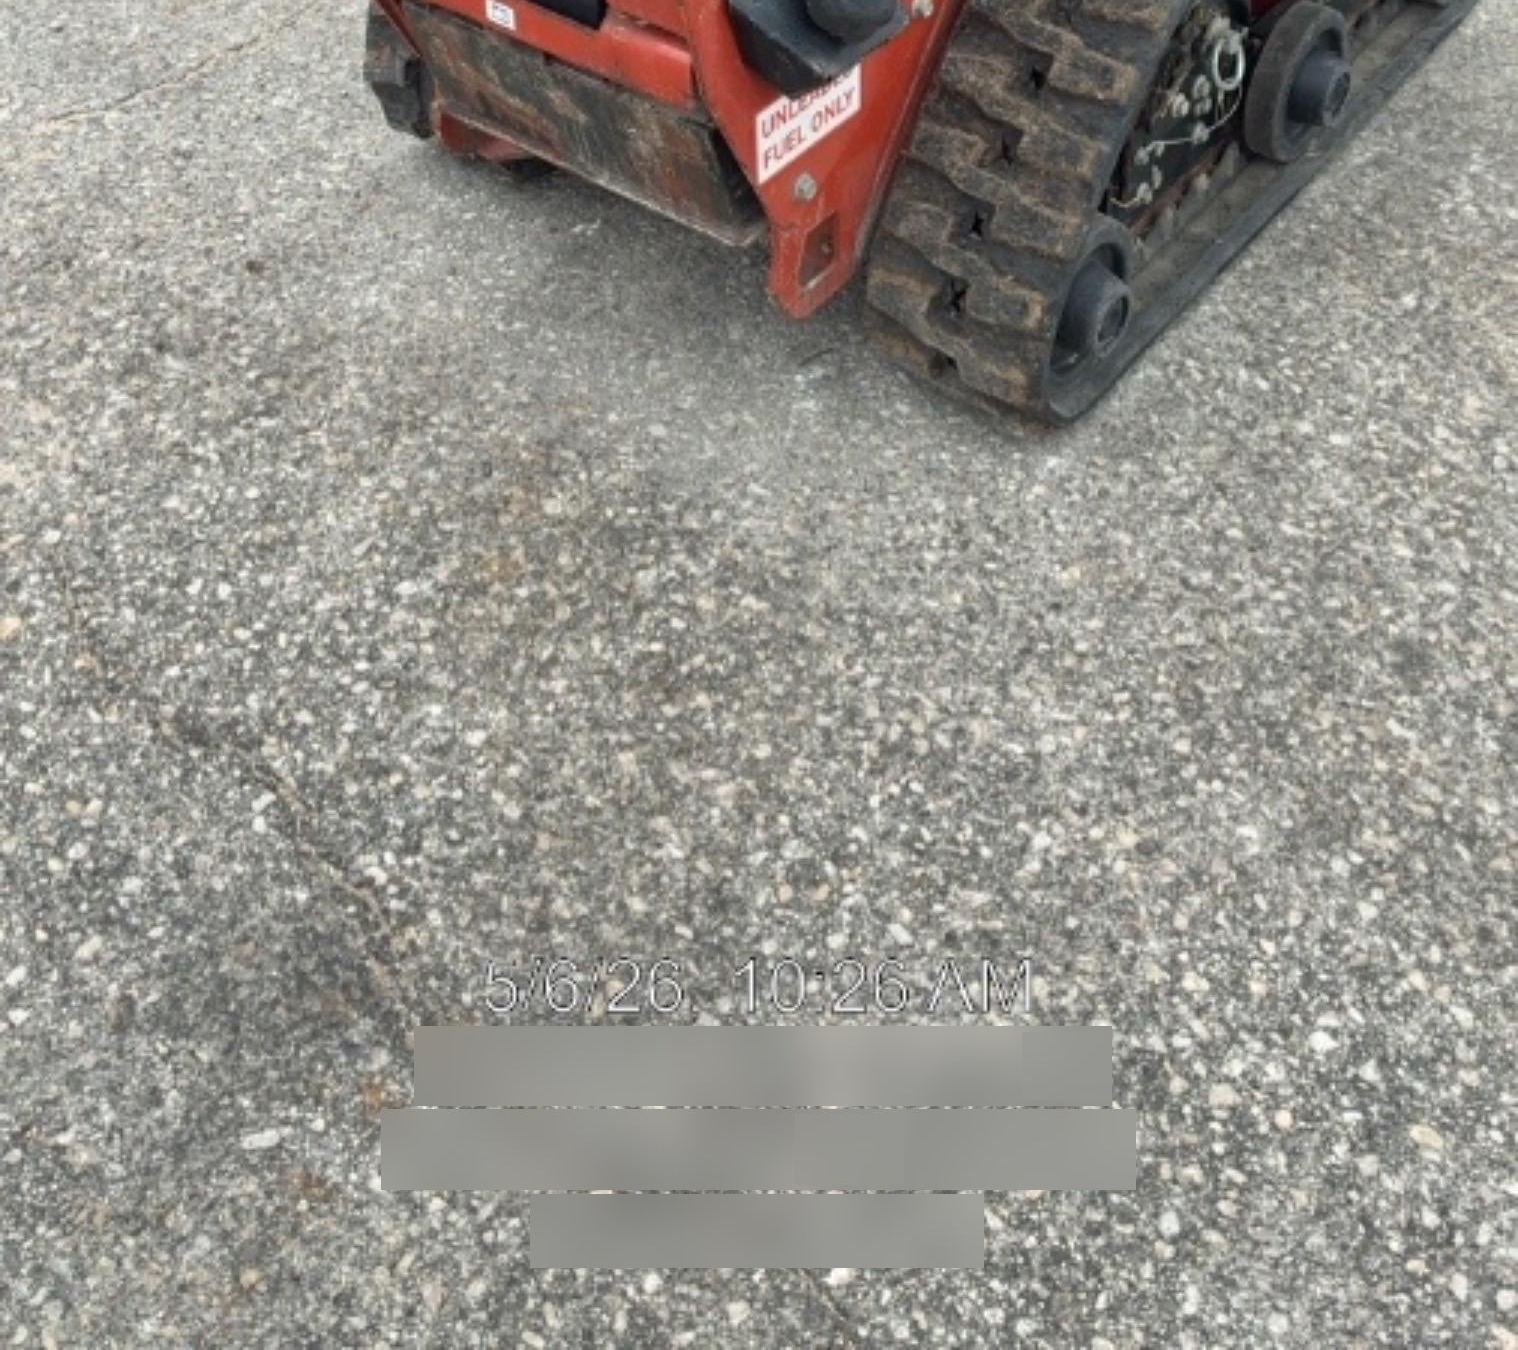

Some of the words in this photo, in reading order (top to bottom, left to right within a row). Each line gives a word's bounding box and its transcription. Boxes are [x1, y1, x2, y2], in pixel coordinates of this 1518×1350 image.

[761, 72, 851, 139] UNLE
[763, 125, 807, 171] FUEL
[810, 87, 856, 132] ONLY
